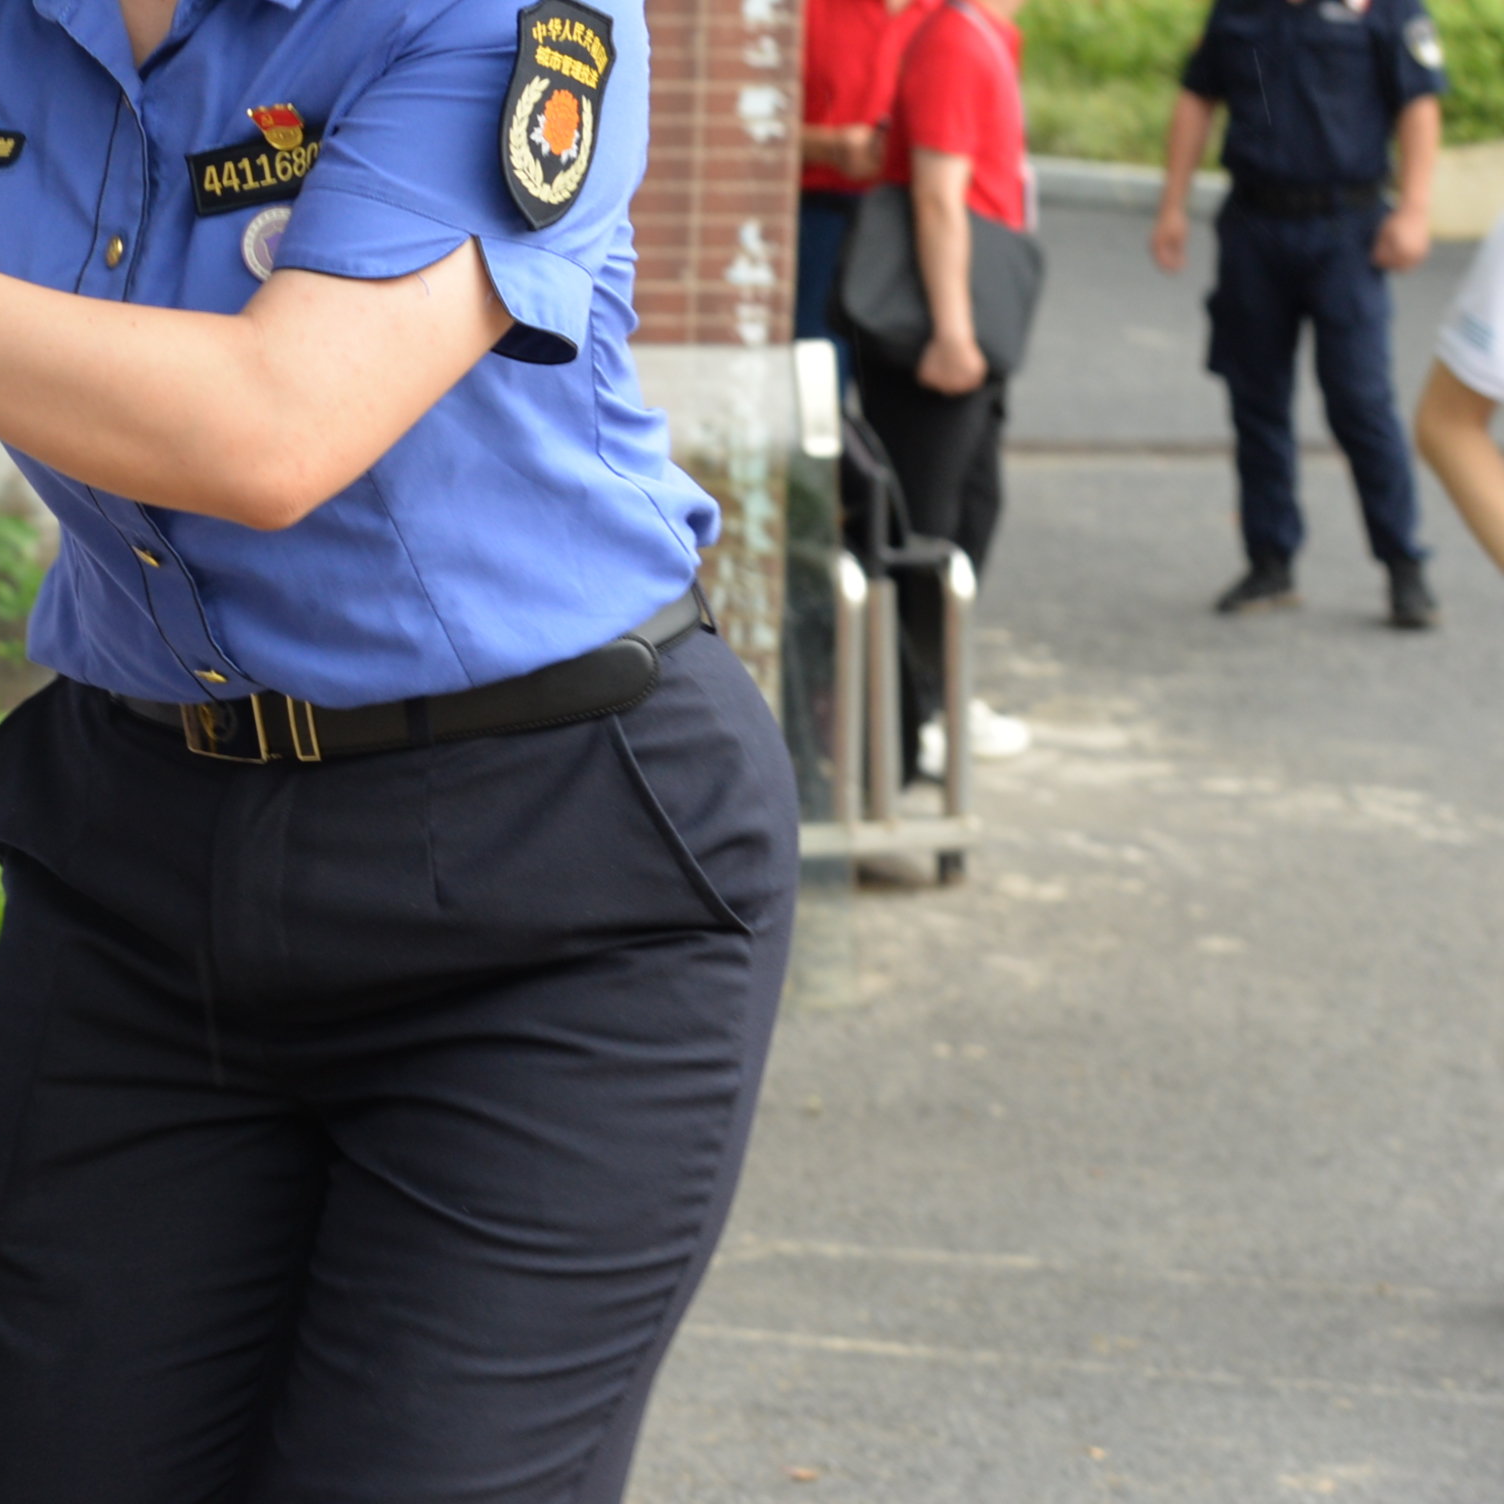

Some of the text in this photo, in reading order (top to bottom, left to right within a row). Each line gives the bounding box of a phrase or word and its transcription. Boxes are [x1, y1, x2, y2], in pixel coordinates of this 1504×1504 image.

[532, 17, 608, 75] 中华人民共和国
